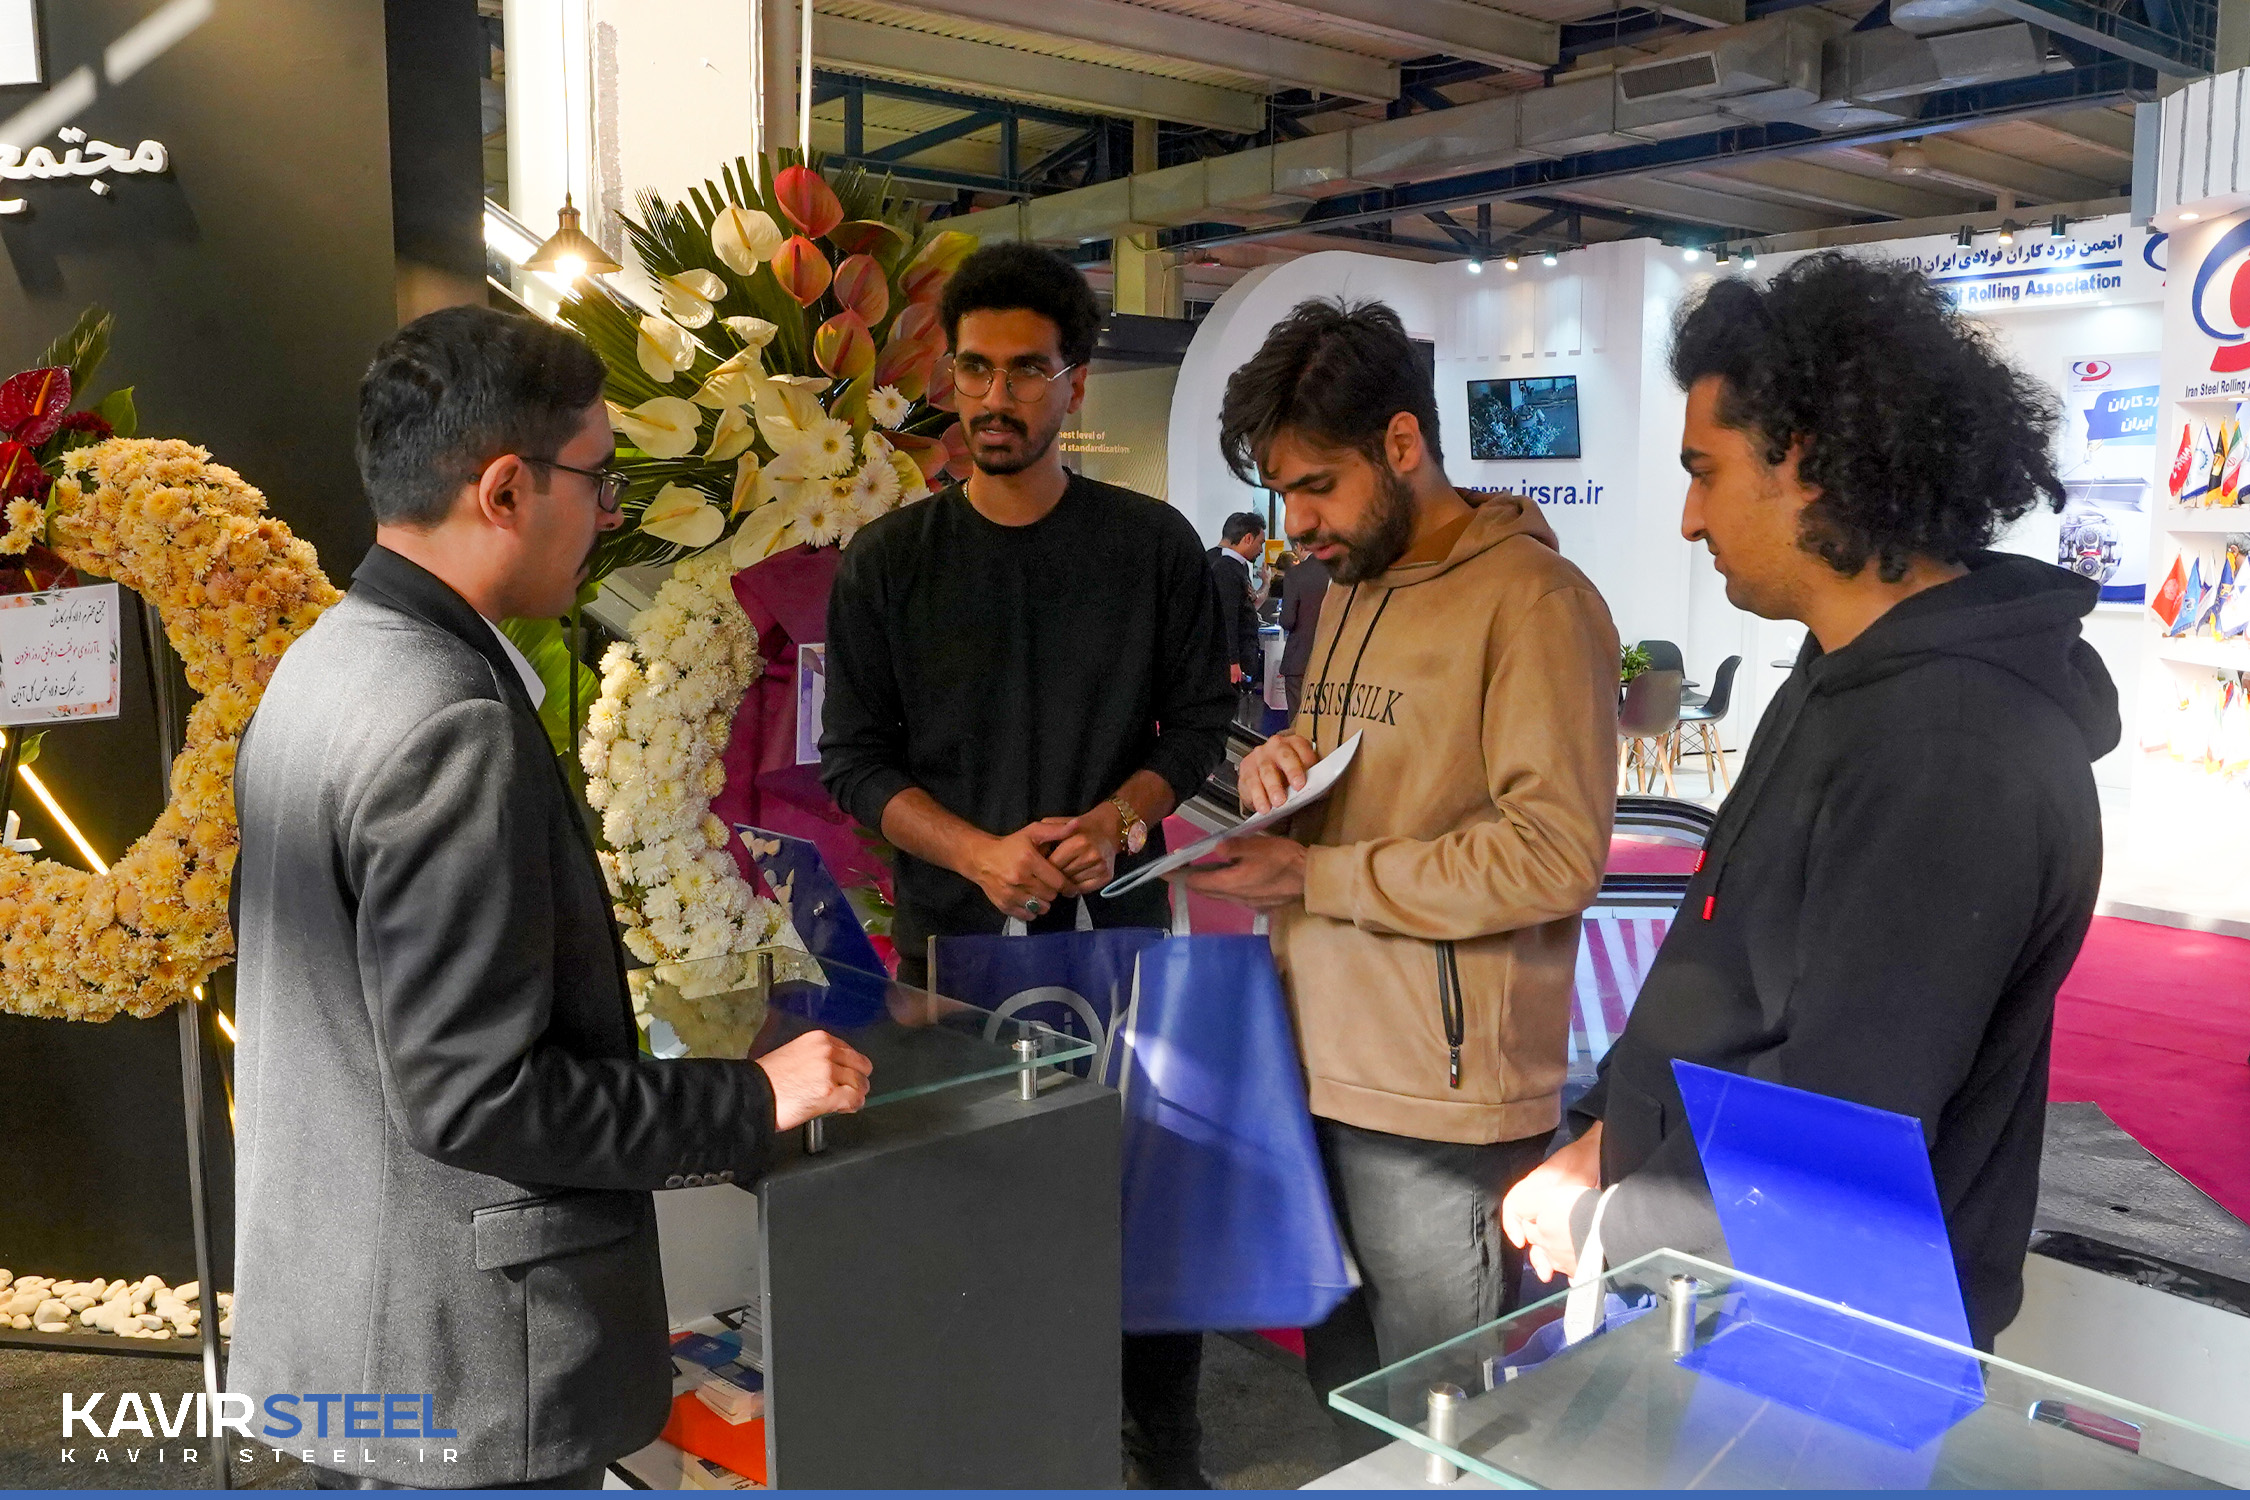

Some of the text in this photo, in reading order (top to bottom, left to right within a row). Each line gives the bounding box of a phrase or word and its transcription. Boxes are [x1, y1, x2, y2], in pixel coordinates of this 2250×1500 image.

[2006, 242, 2044, 264] کاران
[2045, 238, 2077, 261] نورد
[2080, 233, 2123, 257] انجمن
[1923, 253, 1957, 273] ایران
[1958, 246, 2003, 270] فولادی
[1968, 282, 2020, 303] Rolling
[2025, 273, 2121, 297] Association
[2185, 385, 2199, 398] Iran
[2200, 381, 2220, 396] Steel
[2221, 378, 2246, 394] Rolling
[2120, 415, 2154, 432] ایران
[1076, 430, 1095, 440] level
[1096, 431, 1105, 440] of
[1067, 443, 1130, 454] standardization
[59, 670, 77, 698] شرکت
[1301, 682, 1335, 715] ESSI
[1335, 682, 1404, 726] SKSILK
